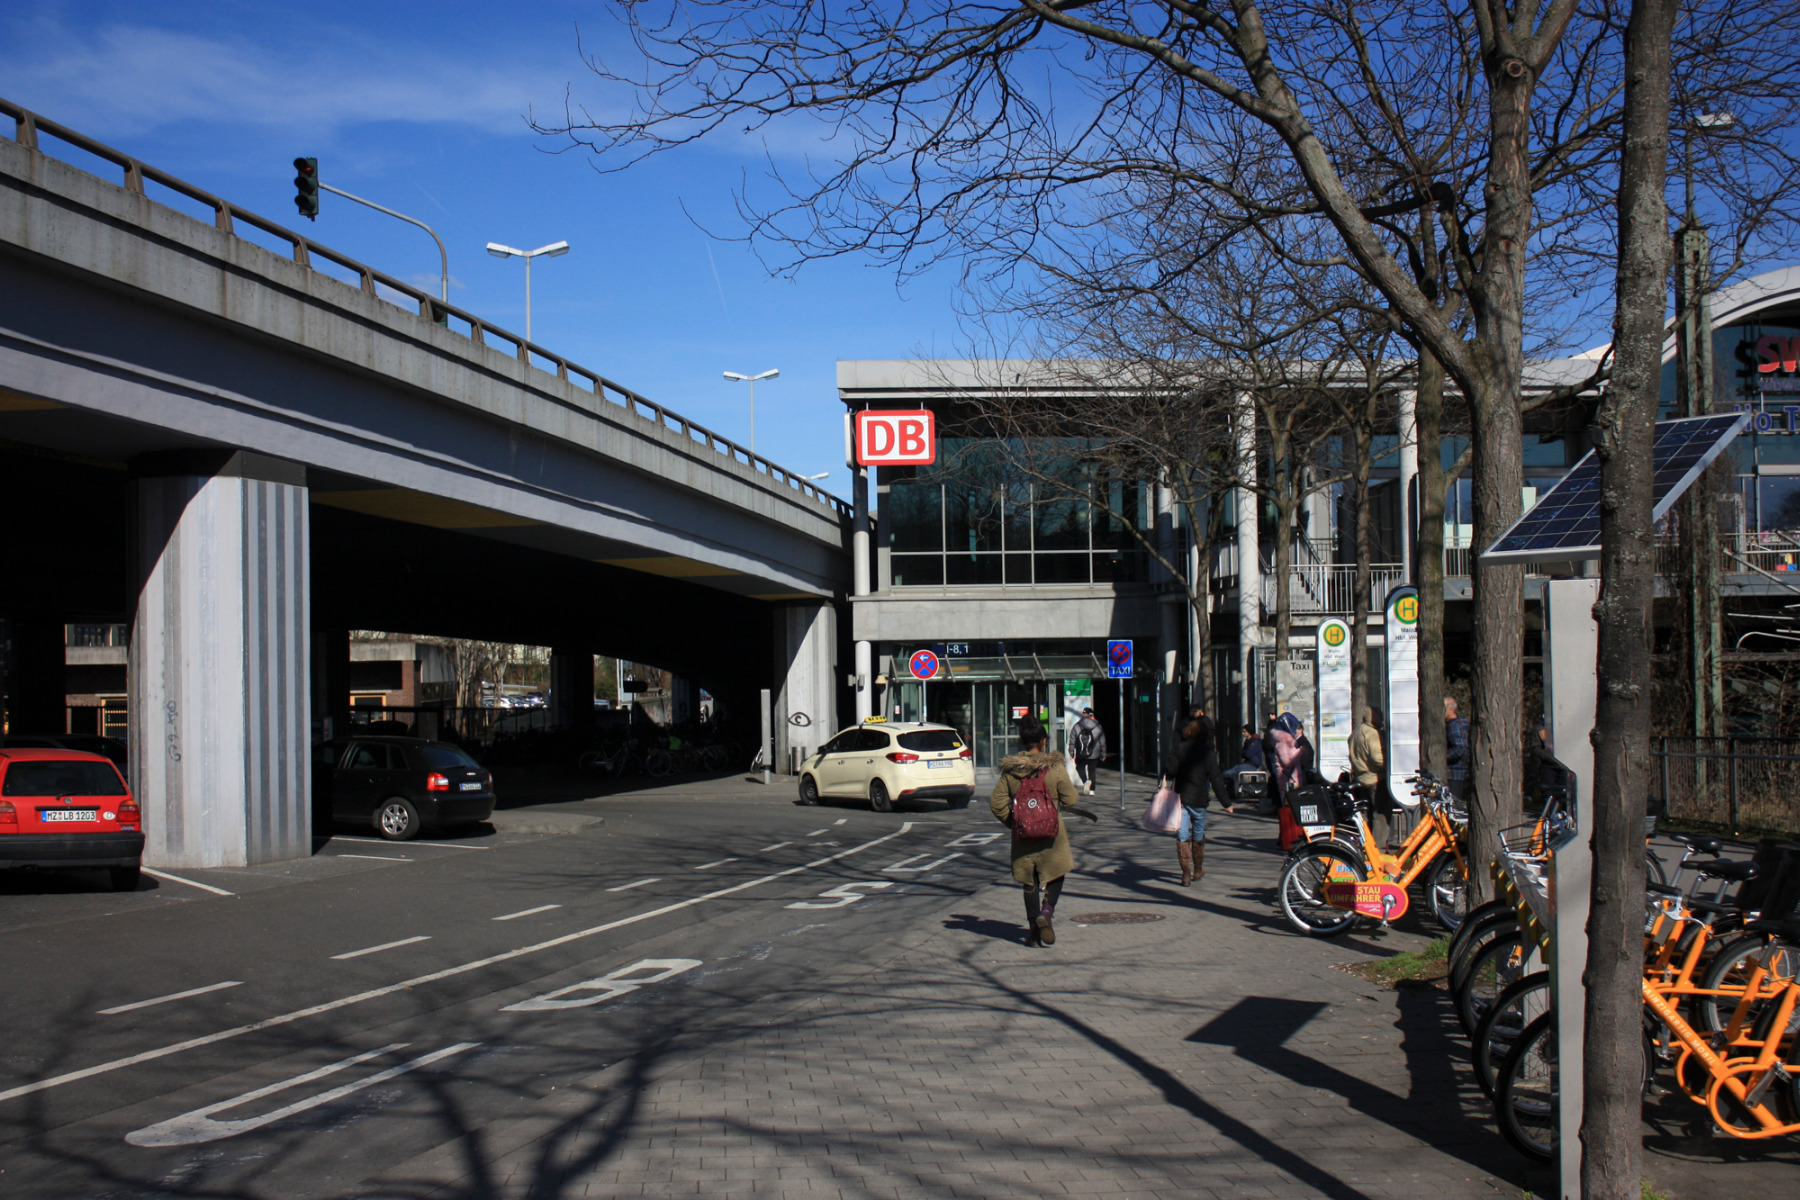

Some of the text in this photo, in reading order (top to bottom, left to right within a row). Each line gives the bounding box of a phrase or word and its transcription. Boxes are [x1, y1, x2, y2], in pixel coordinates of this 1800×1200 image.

[866, 420, 926, 457] DB
[1110, 666, 1131, 675] TAXI
[1290, 661, 1310, 671] Taxi
[47, 811, 96, 821] MZ LB 1203
[1357, 886, 1381, 895] STAU
[1330, 894, 1381, 903] UMFAHRER
